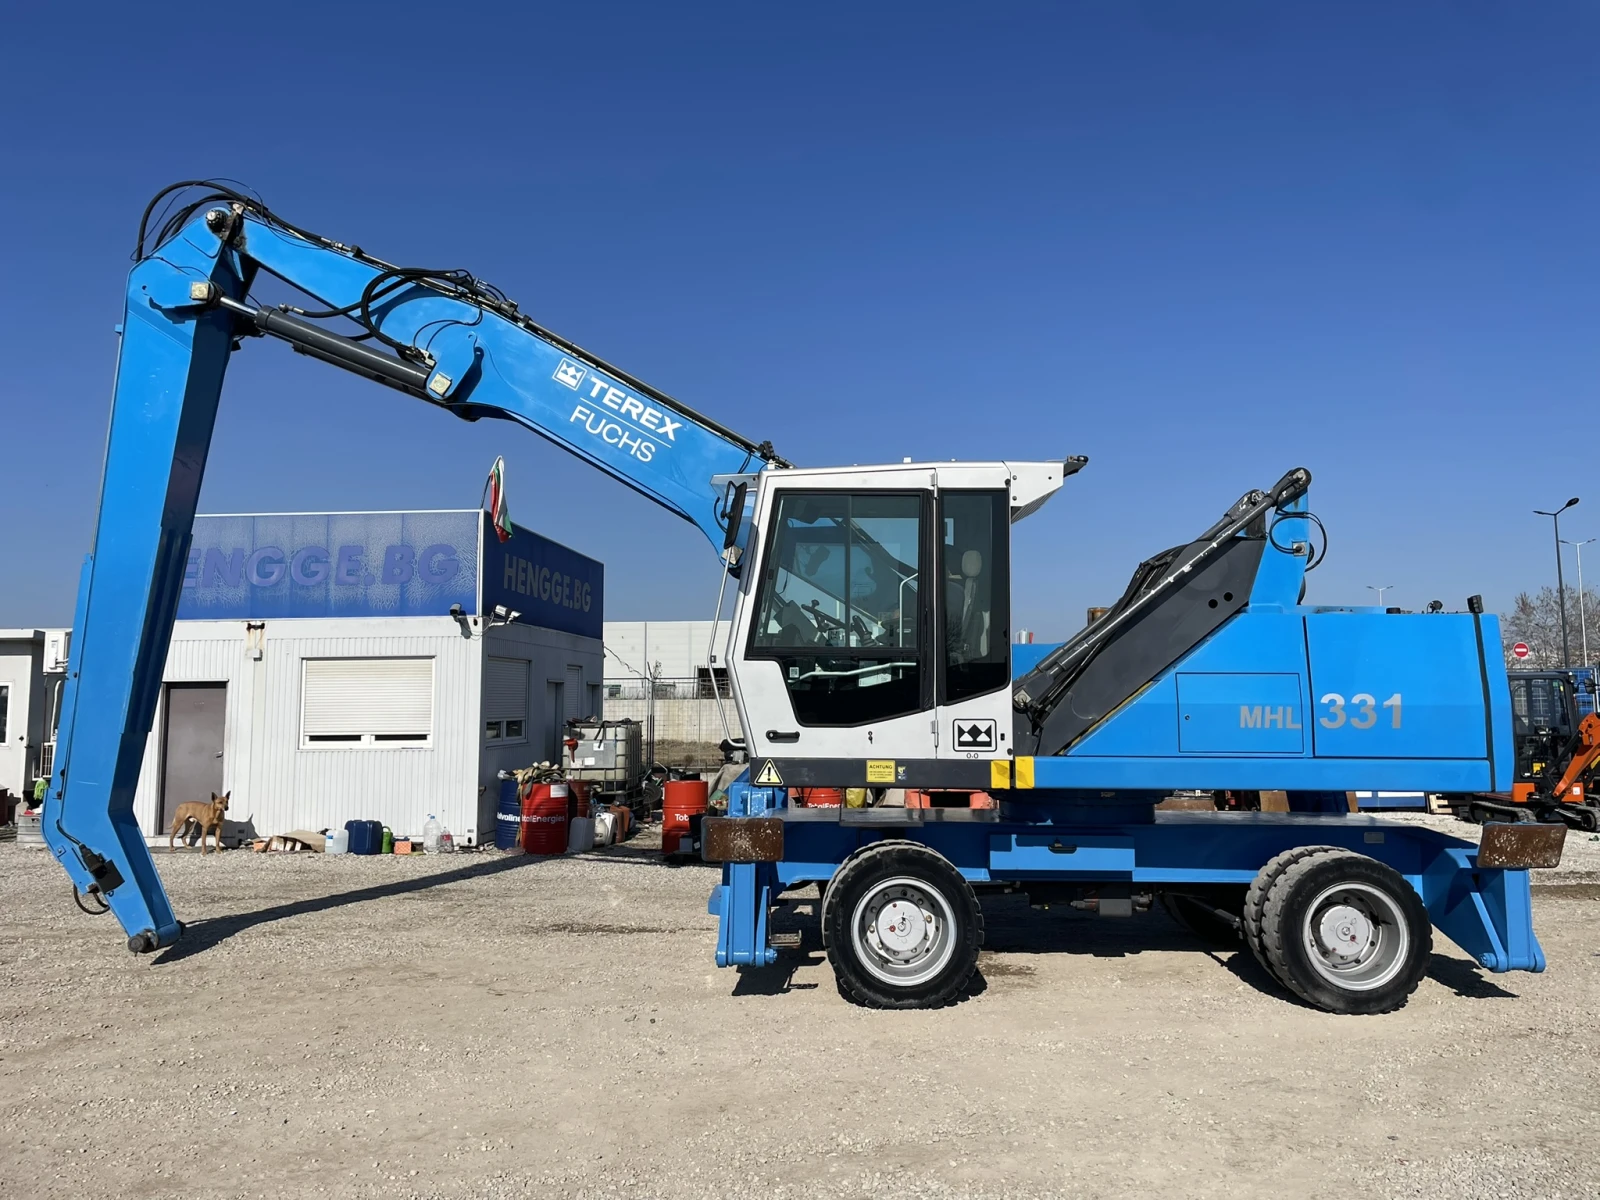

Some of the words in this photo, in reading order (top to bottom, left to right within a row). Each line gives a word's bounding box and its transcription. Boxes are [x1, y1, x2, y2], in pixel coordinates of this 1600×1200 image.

[569, 405, 656, 462] FUCHS
[589, 376, 683, 441] TEREX
[503, 553, 592, 612] HENGGE.BG
[1239, 705, 1302, 729] MHL
[1319, 693, 1402, 729] 331
